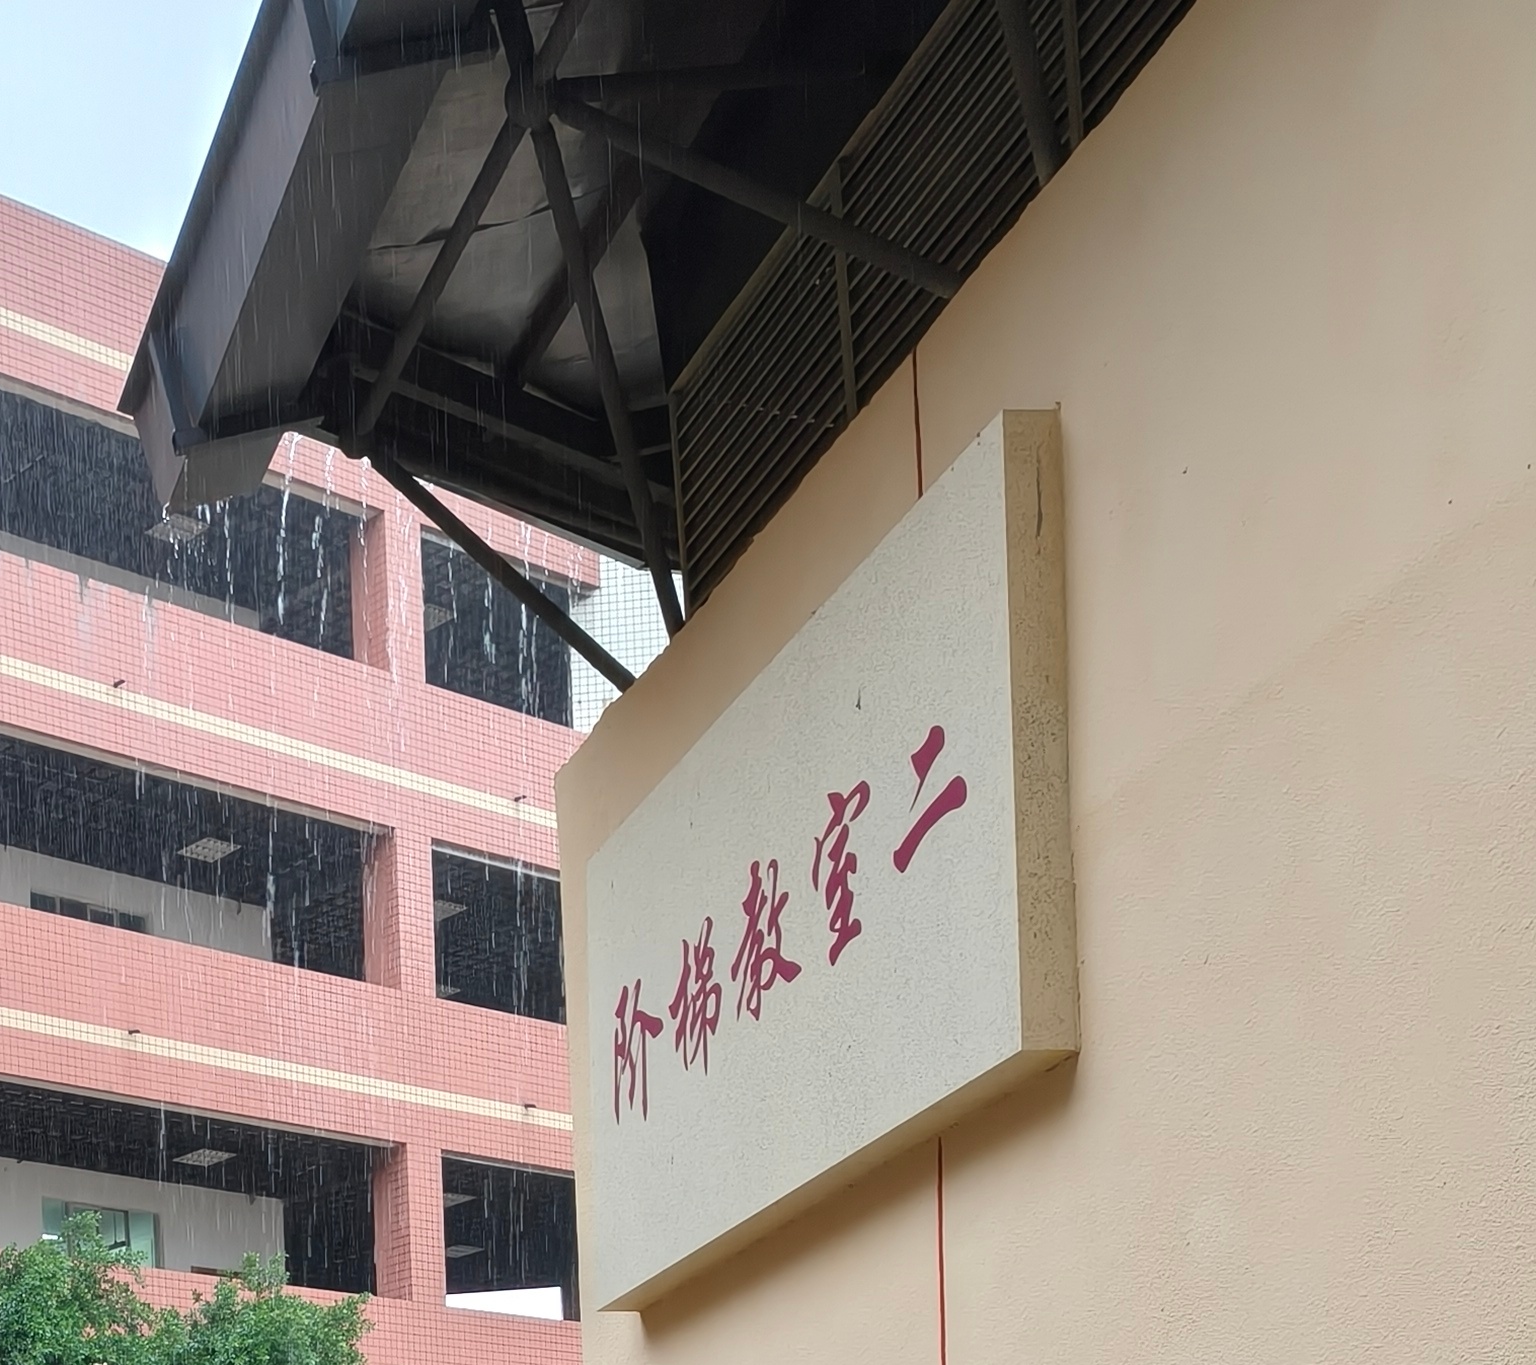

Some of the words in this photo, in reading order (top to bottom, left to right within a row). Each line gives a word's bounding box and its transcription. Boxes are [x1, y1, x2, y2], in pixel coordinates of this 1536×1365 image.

[614, 725, 968, 1125] 阶梯教室二
